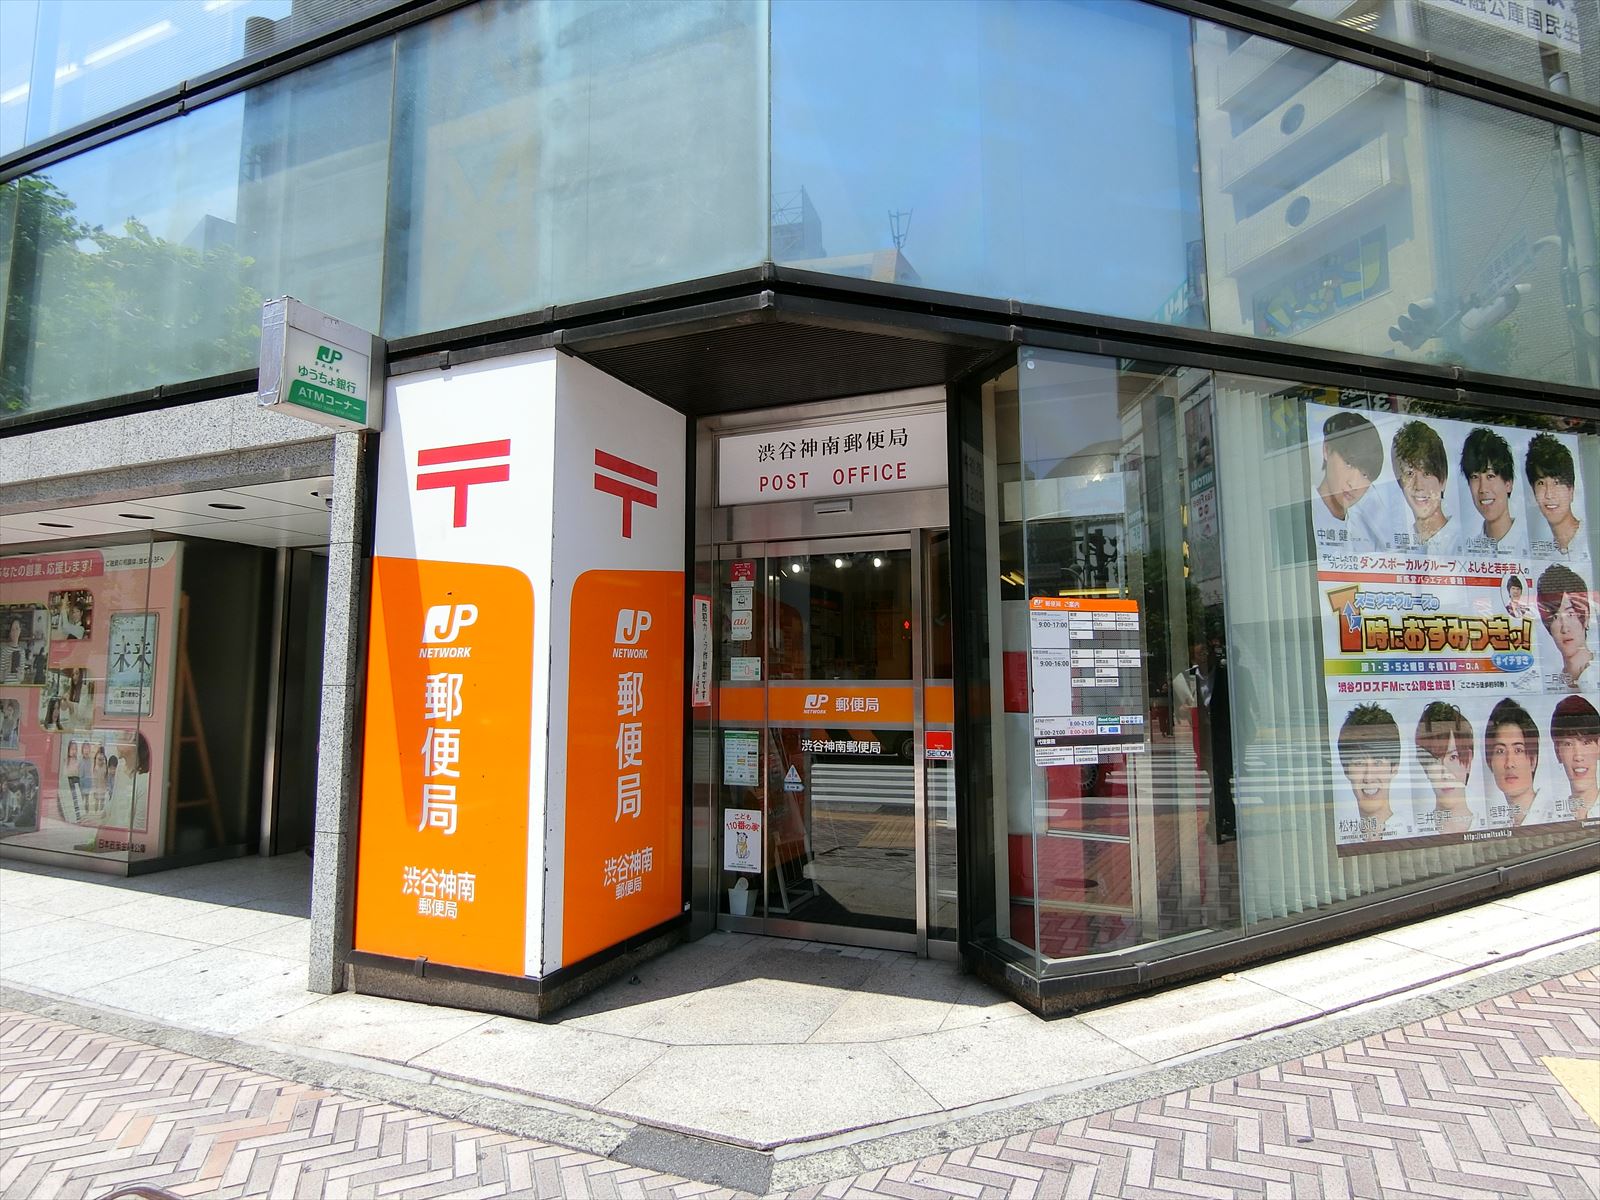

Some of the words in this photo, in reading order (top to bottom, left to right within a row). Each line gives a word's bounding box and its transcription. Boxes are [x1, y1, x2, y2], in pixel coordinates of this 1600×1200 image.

[316, 345, 343, 364] JP
[298, 365, 357, 395] ゆうちょ銀行
[314, 361, 341, 374] BANK
[298, 386, 361, 411] ATMコーナー
[757, 427, 909, 463] 渋谷神南郵便局
[759, 471, 809, 492] POST
[832, 462, 908, 485] OFFICE
[1322, 553, 1358, 561] デビューしたての
[1330, 561, 1359, 570] フレッシュな
[421, 604, 478, 643] JP
[614, 608, 652, 645] JP
[112, 637, 151, 673] 未来
[419, 646, 472, 659] NETWORK
[612, 648, 649, 659] NETWORK
[804, 694, 829, 709] JP
[835, 696, 880, 713] 郵便局
[418, 671, 464, 835] 郵便局
[614, 671, 644, 823] 郵便局
[801, 739, 881, 754] 渋谷神南郵便局
[734, 812, 752, 821] こども
[603, 846, 653, 887] 渋谷神南
[402, 865, 476, 903] 渋谷神南
[615, 876, 642, 901] 郵便局
[418, 897, 458, 919] 郵便局
